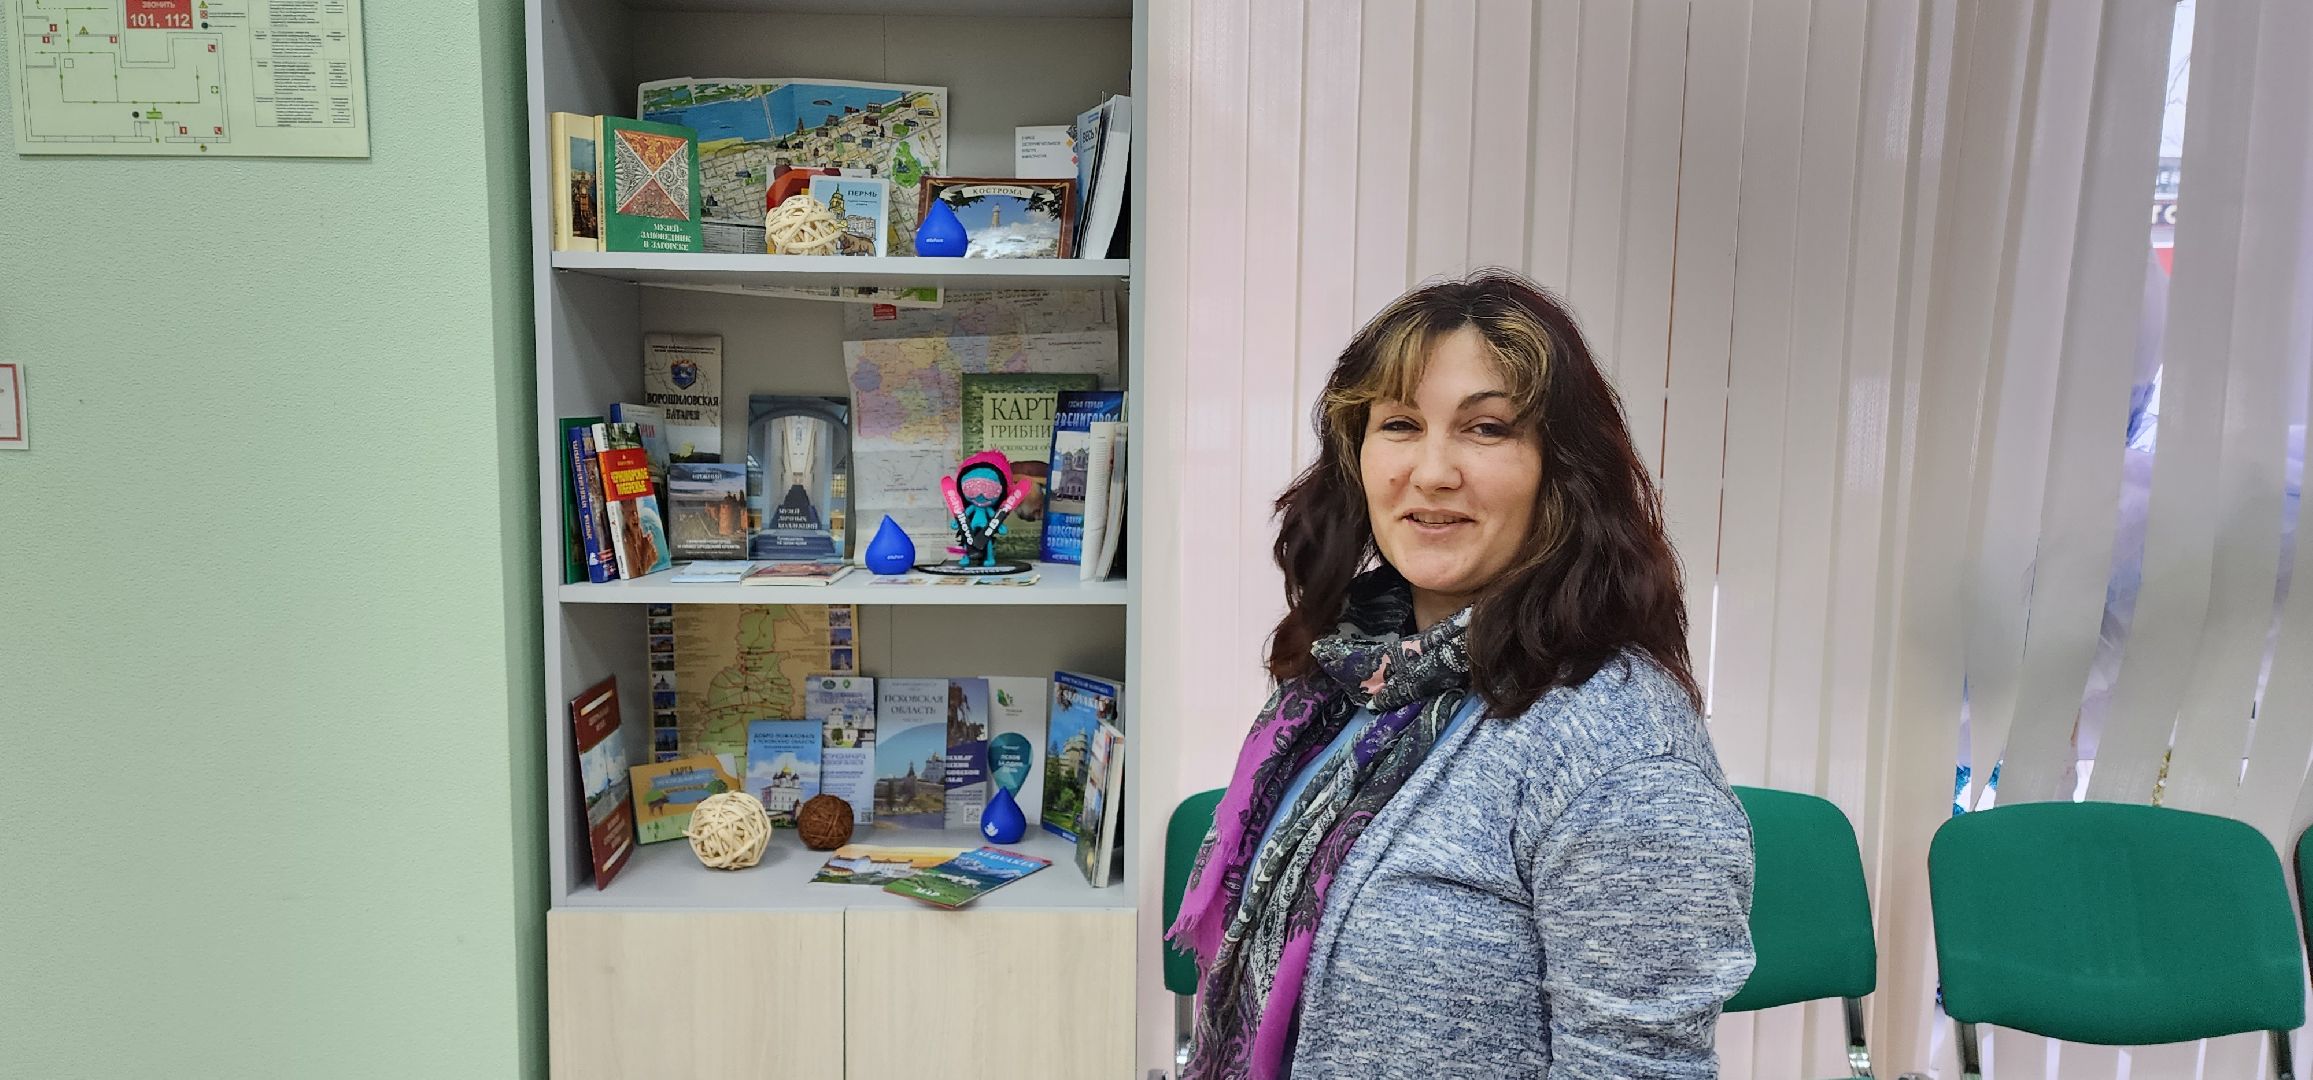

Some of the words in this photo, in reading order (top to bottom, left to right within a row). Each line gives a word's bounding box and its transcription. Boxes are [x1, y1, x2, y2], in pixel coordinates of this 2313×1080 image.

[130, 13, 160, 28] 101,
[165, 13, 190, 27] 112
[847, 189, 878, 198] ПЕРМЬ
[972, 188, 1023, 196] КОСТРОМА
[640, 231, 692, 242] ЗАПОВЕДНИК
[643, 240, 649, 248] В
[652, 241, 689, 251] ЗАГОРСКЕ
[646, 393, 719, 406] ВОРОШИЛОВСКАЯ
[666, 408, 700, 420] БАТАРЕЯ
[990, 397, 1055, 420] КАРТ
[991, 425, 1051, 438] ГРИБНИ
[884, 695, 944, 704] ПСКОВСКАЯ
[891, 706, 936, 715] ОБЛАСТЬ
